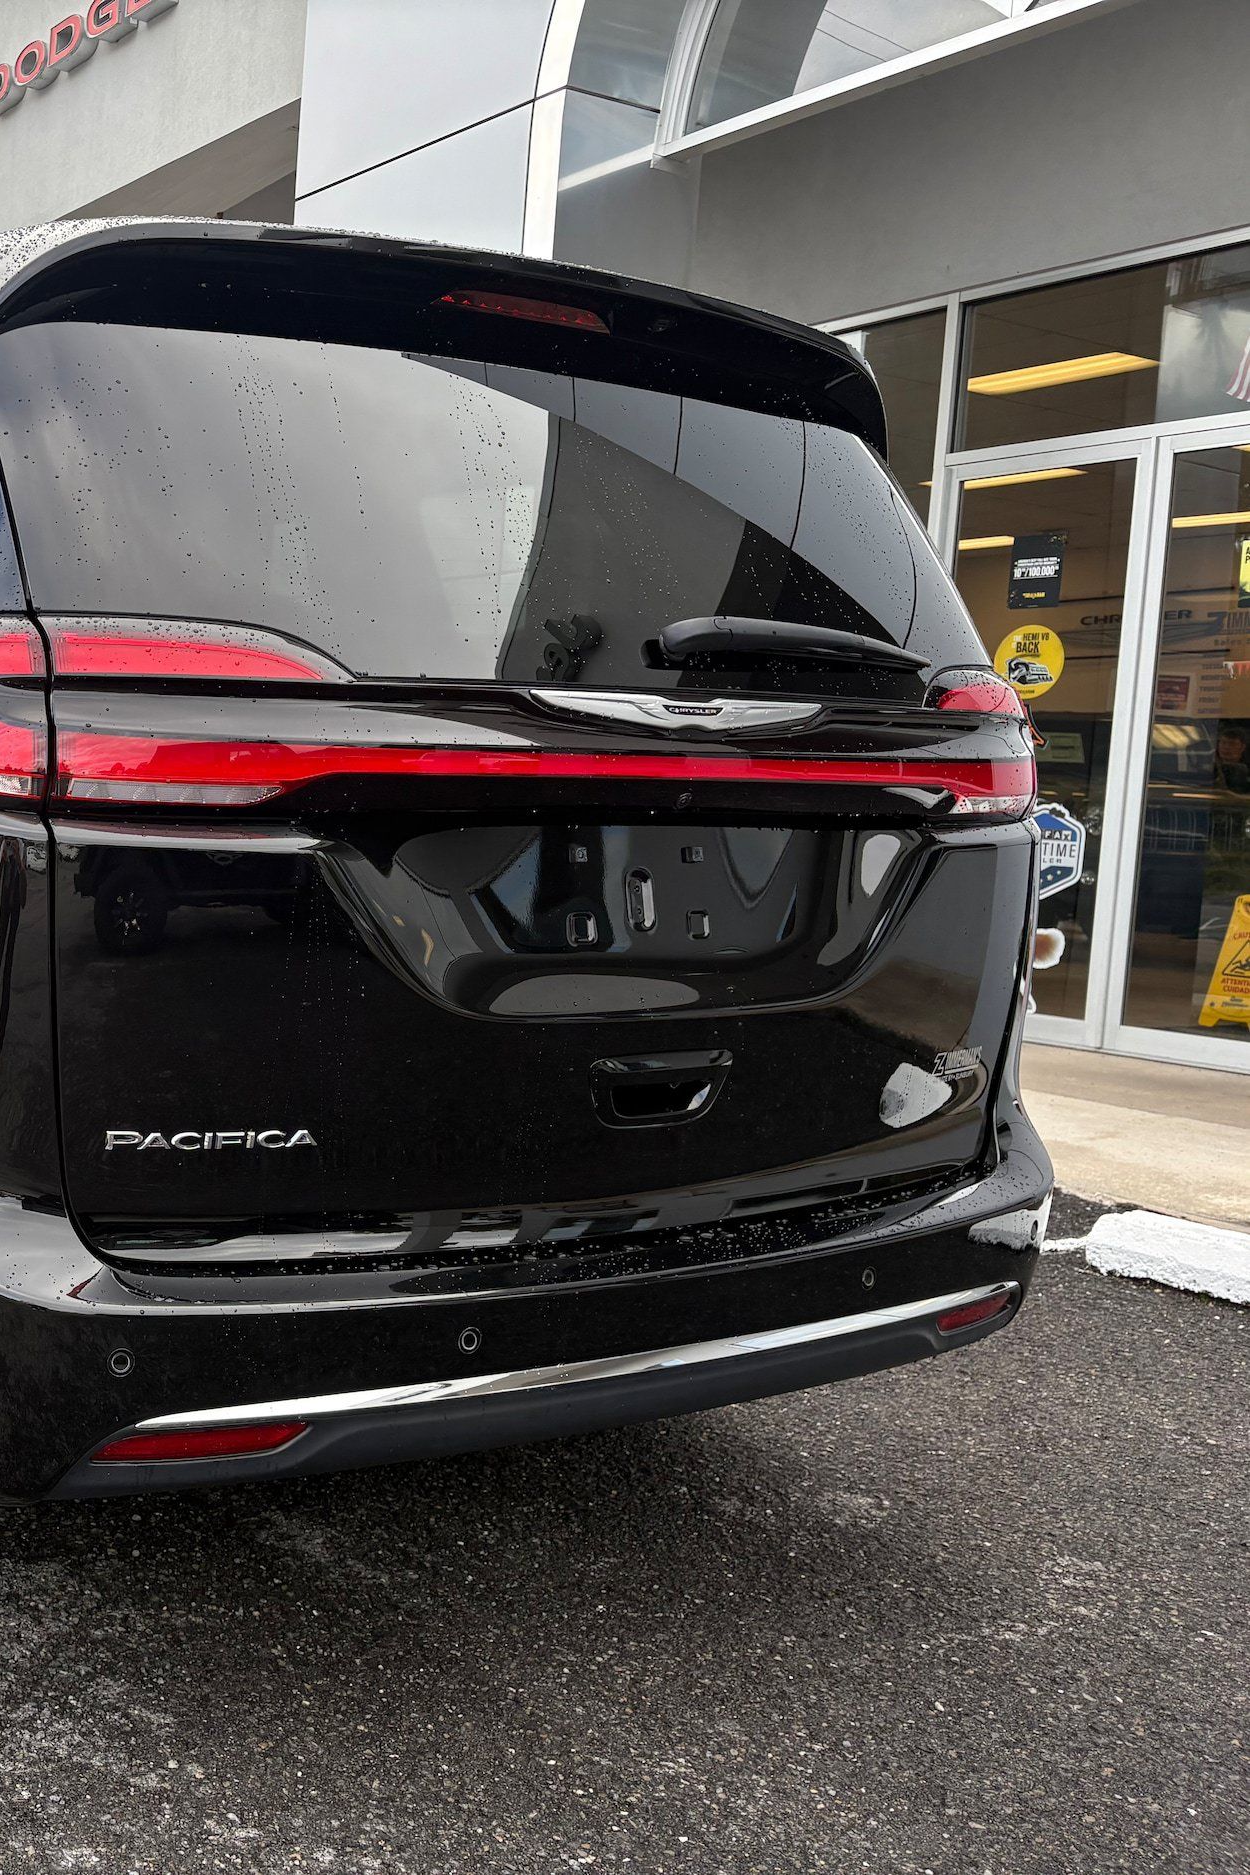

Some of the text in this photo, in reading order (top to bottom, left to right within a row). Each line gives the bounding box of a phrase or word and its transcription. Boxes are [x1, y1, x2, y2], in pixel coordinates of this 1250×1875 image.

[1023, 633, 1040, 641] HEMI
[1016, 641, 1040, 653] BACK
[669, 706, 717, 715] CHRYSLER
[1044, 830, 1072, 841] FAX
[105, 1129, 318, 1150] PACIFICA
